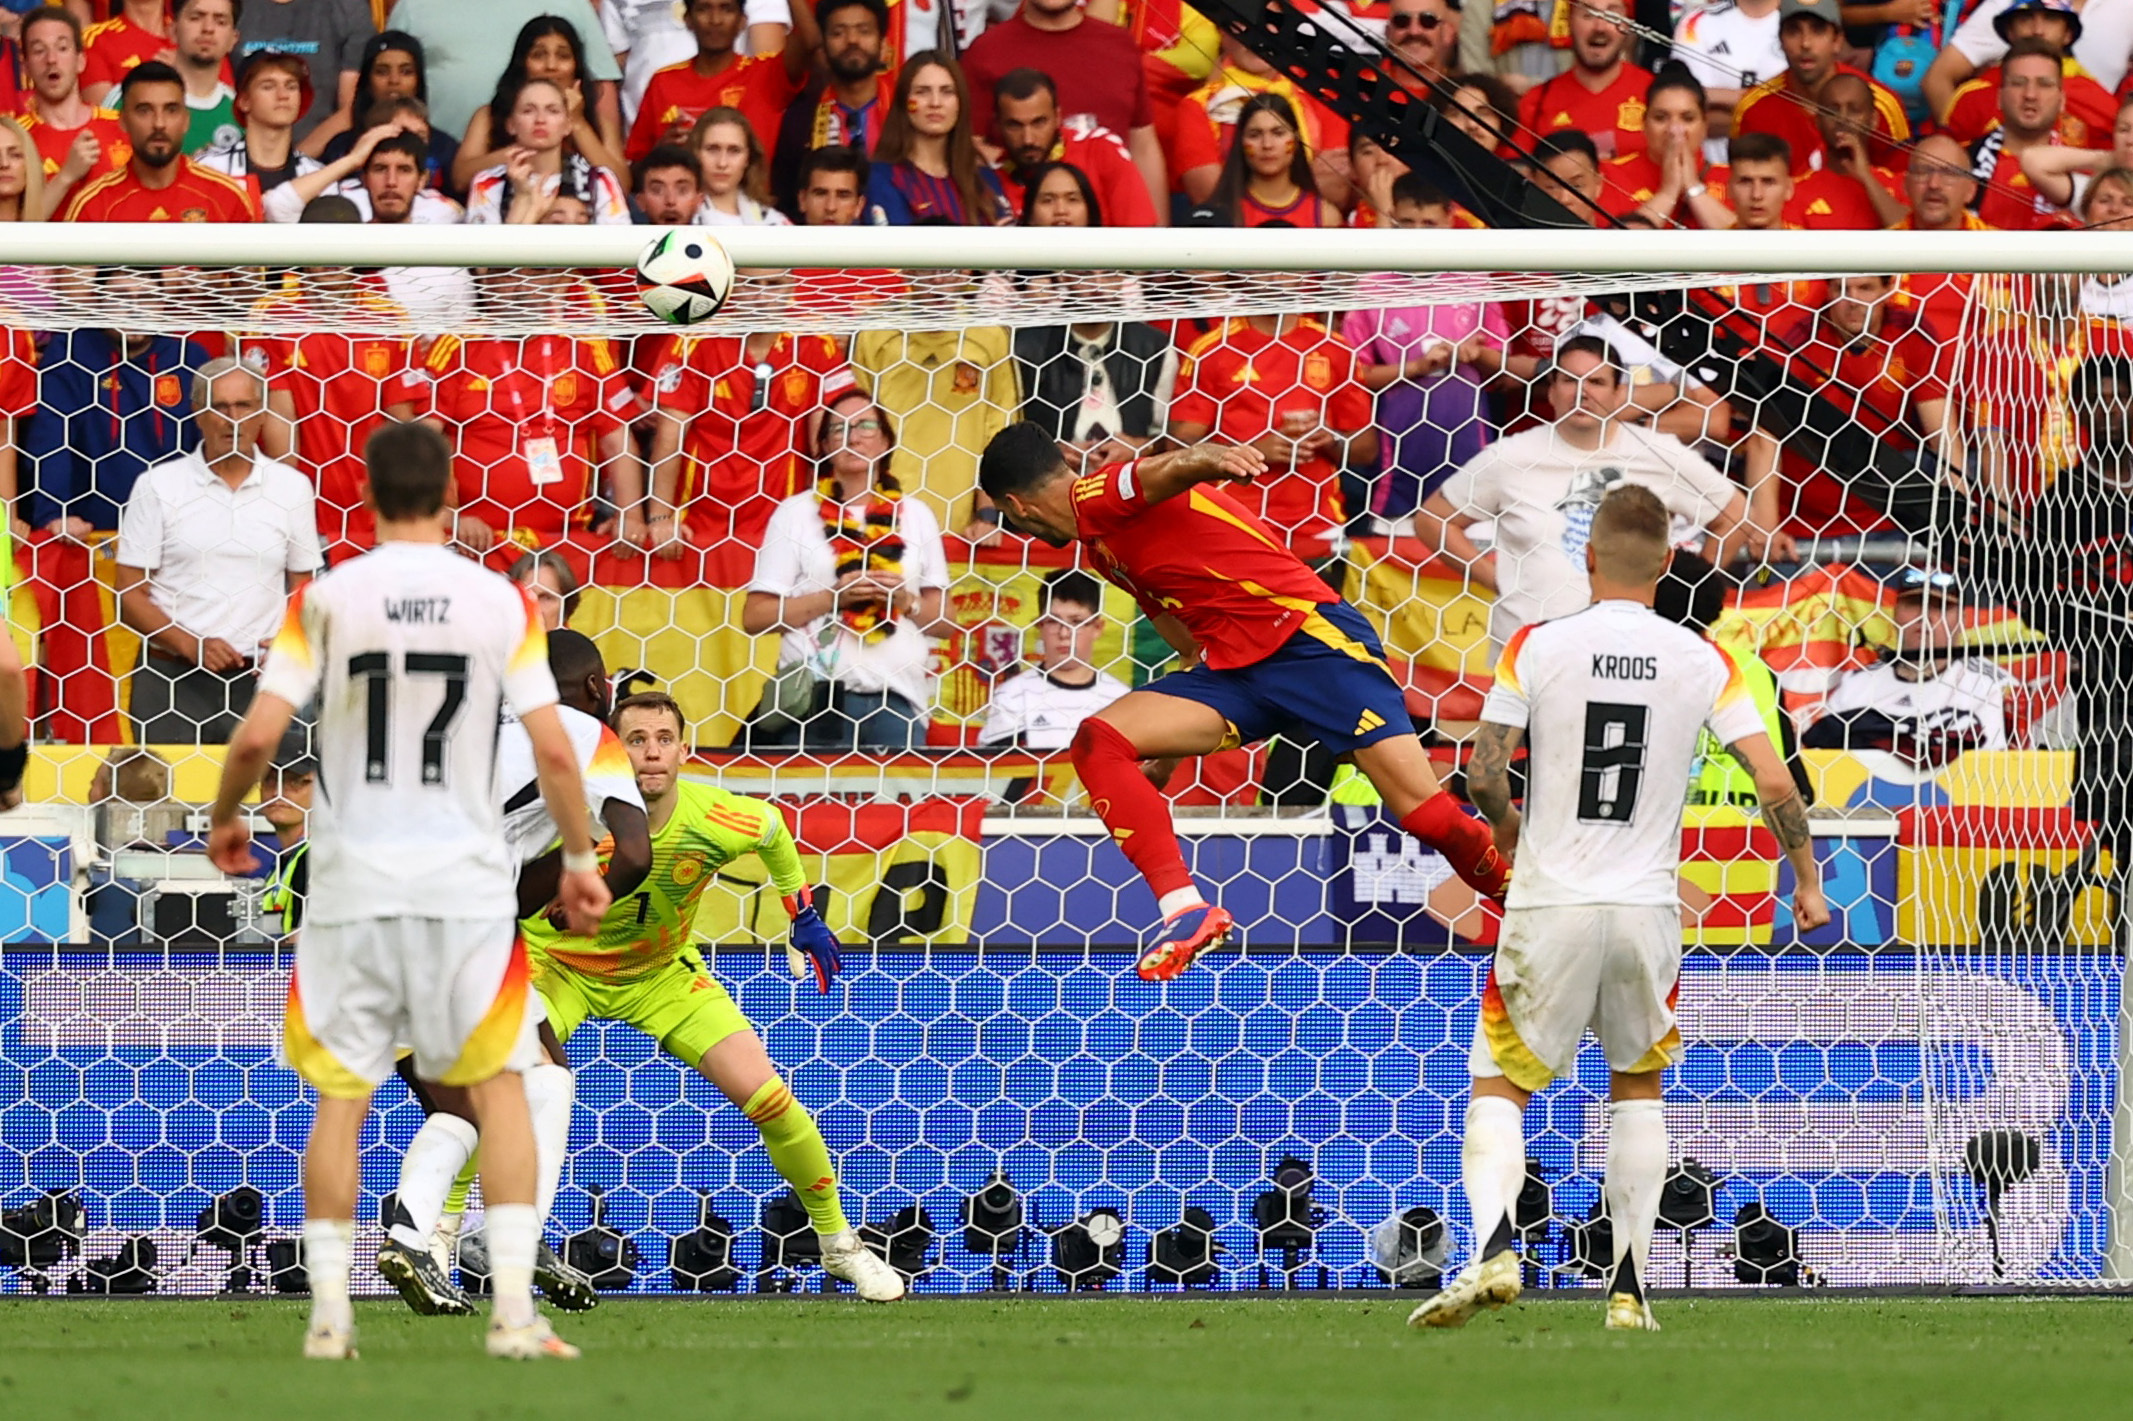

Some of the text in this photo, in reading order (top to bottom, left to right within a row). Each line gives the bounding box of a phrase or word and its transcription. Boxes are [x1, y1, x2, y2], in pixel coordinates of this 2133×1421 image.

[385, 598, 451, 624] WIRTZ
[1591, 654, 1658, 681] KROOS
[349, 651, 474, 788] 17
[1577, 700, 1651, 828] 8
[633, 891, 650, 924] 1
